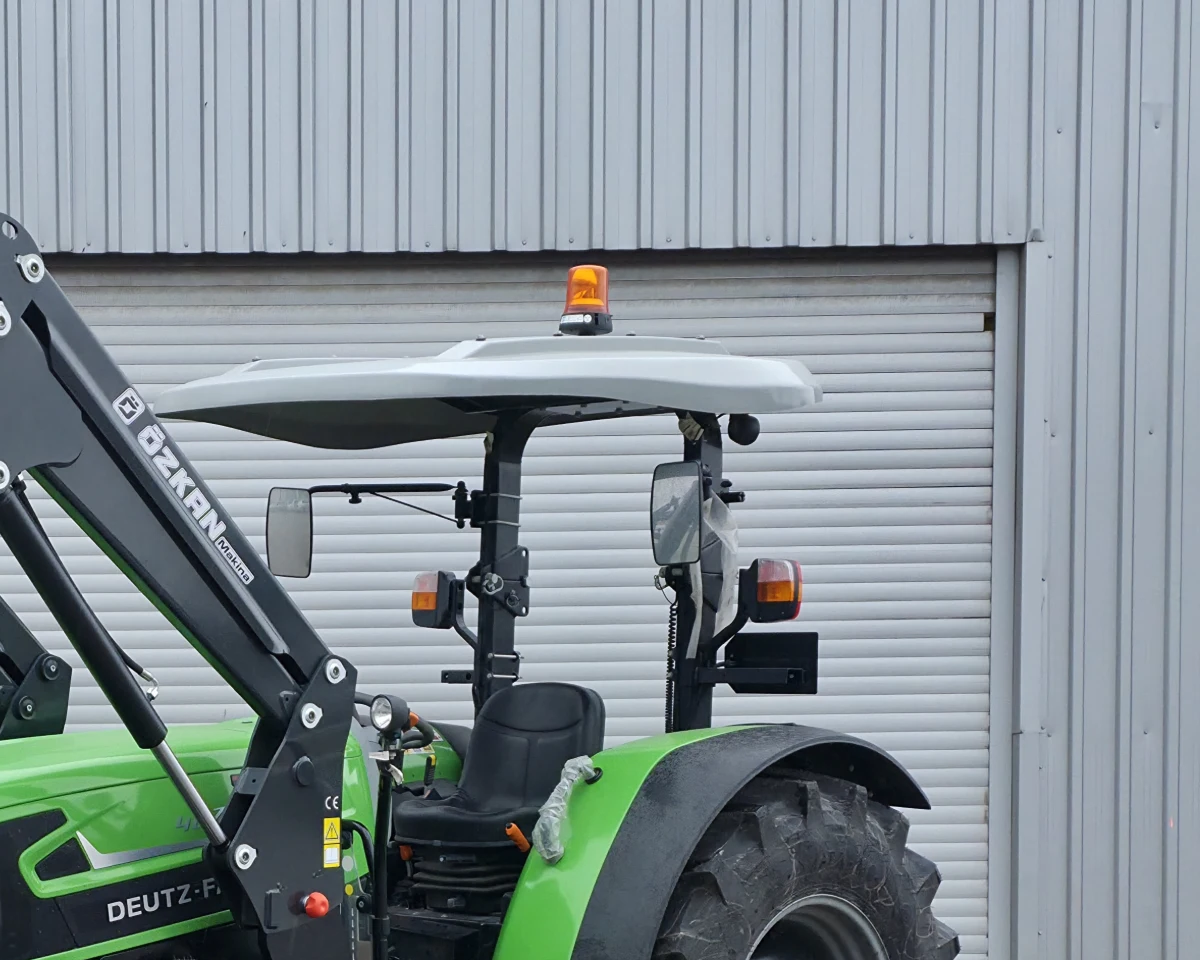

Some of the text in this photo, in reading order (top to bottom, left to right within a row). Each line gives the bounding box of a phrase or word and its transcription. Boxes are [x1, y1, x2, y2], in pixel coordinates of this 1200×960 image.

[217, 539, 250, 583] Makina
[325, 795, 339, 810] CE
[107, 877, 221, 922] DEUTZ-F
